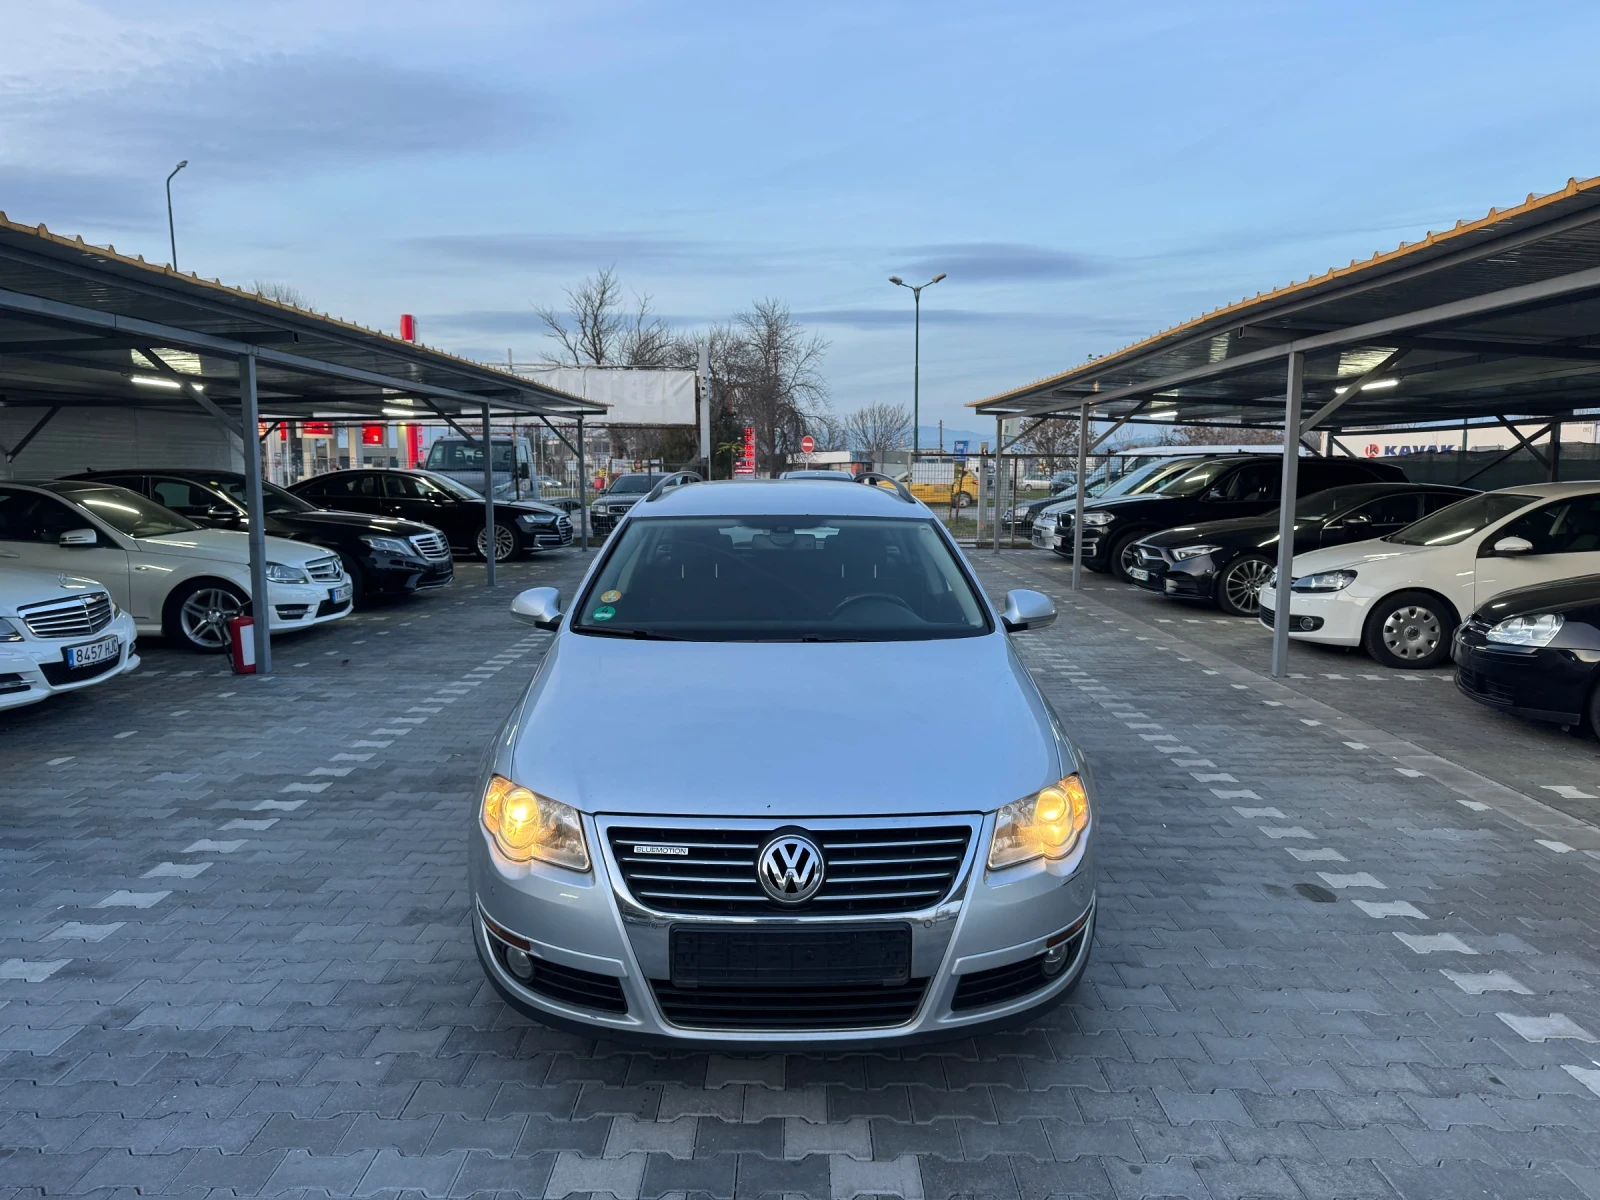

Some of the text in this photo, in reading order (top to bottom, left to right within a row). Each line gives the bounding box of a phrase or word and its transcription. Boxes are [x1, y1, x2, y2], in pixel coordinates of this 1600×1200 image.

[76, 645, 103, 663] 8457
[105, 639, 118, 656] HJC
[636, 846, 687, 855] BLUEMOTION
